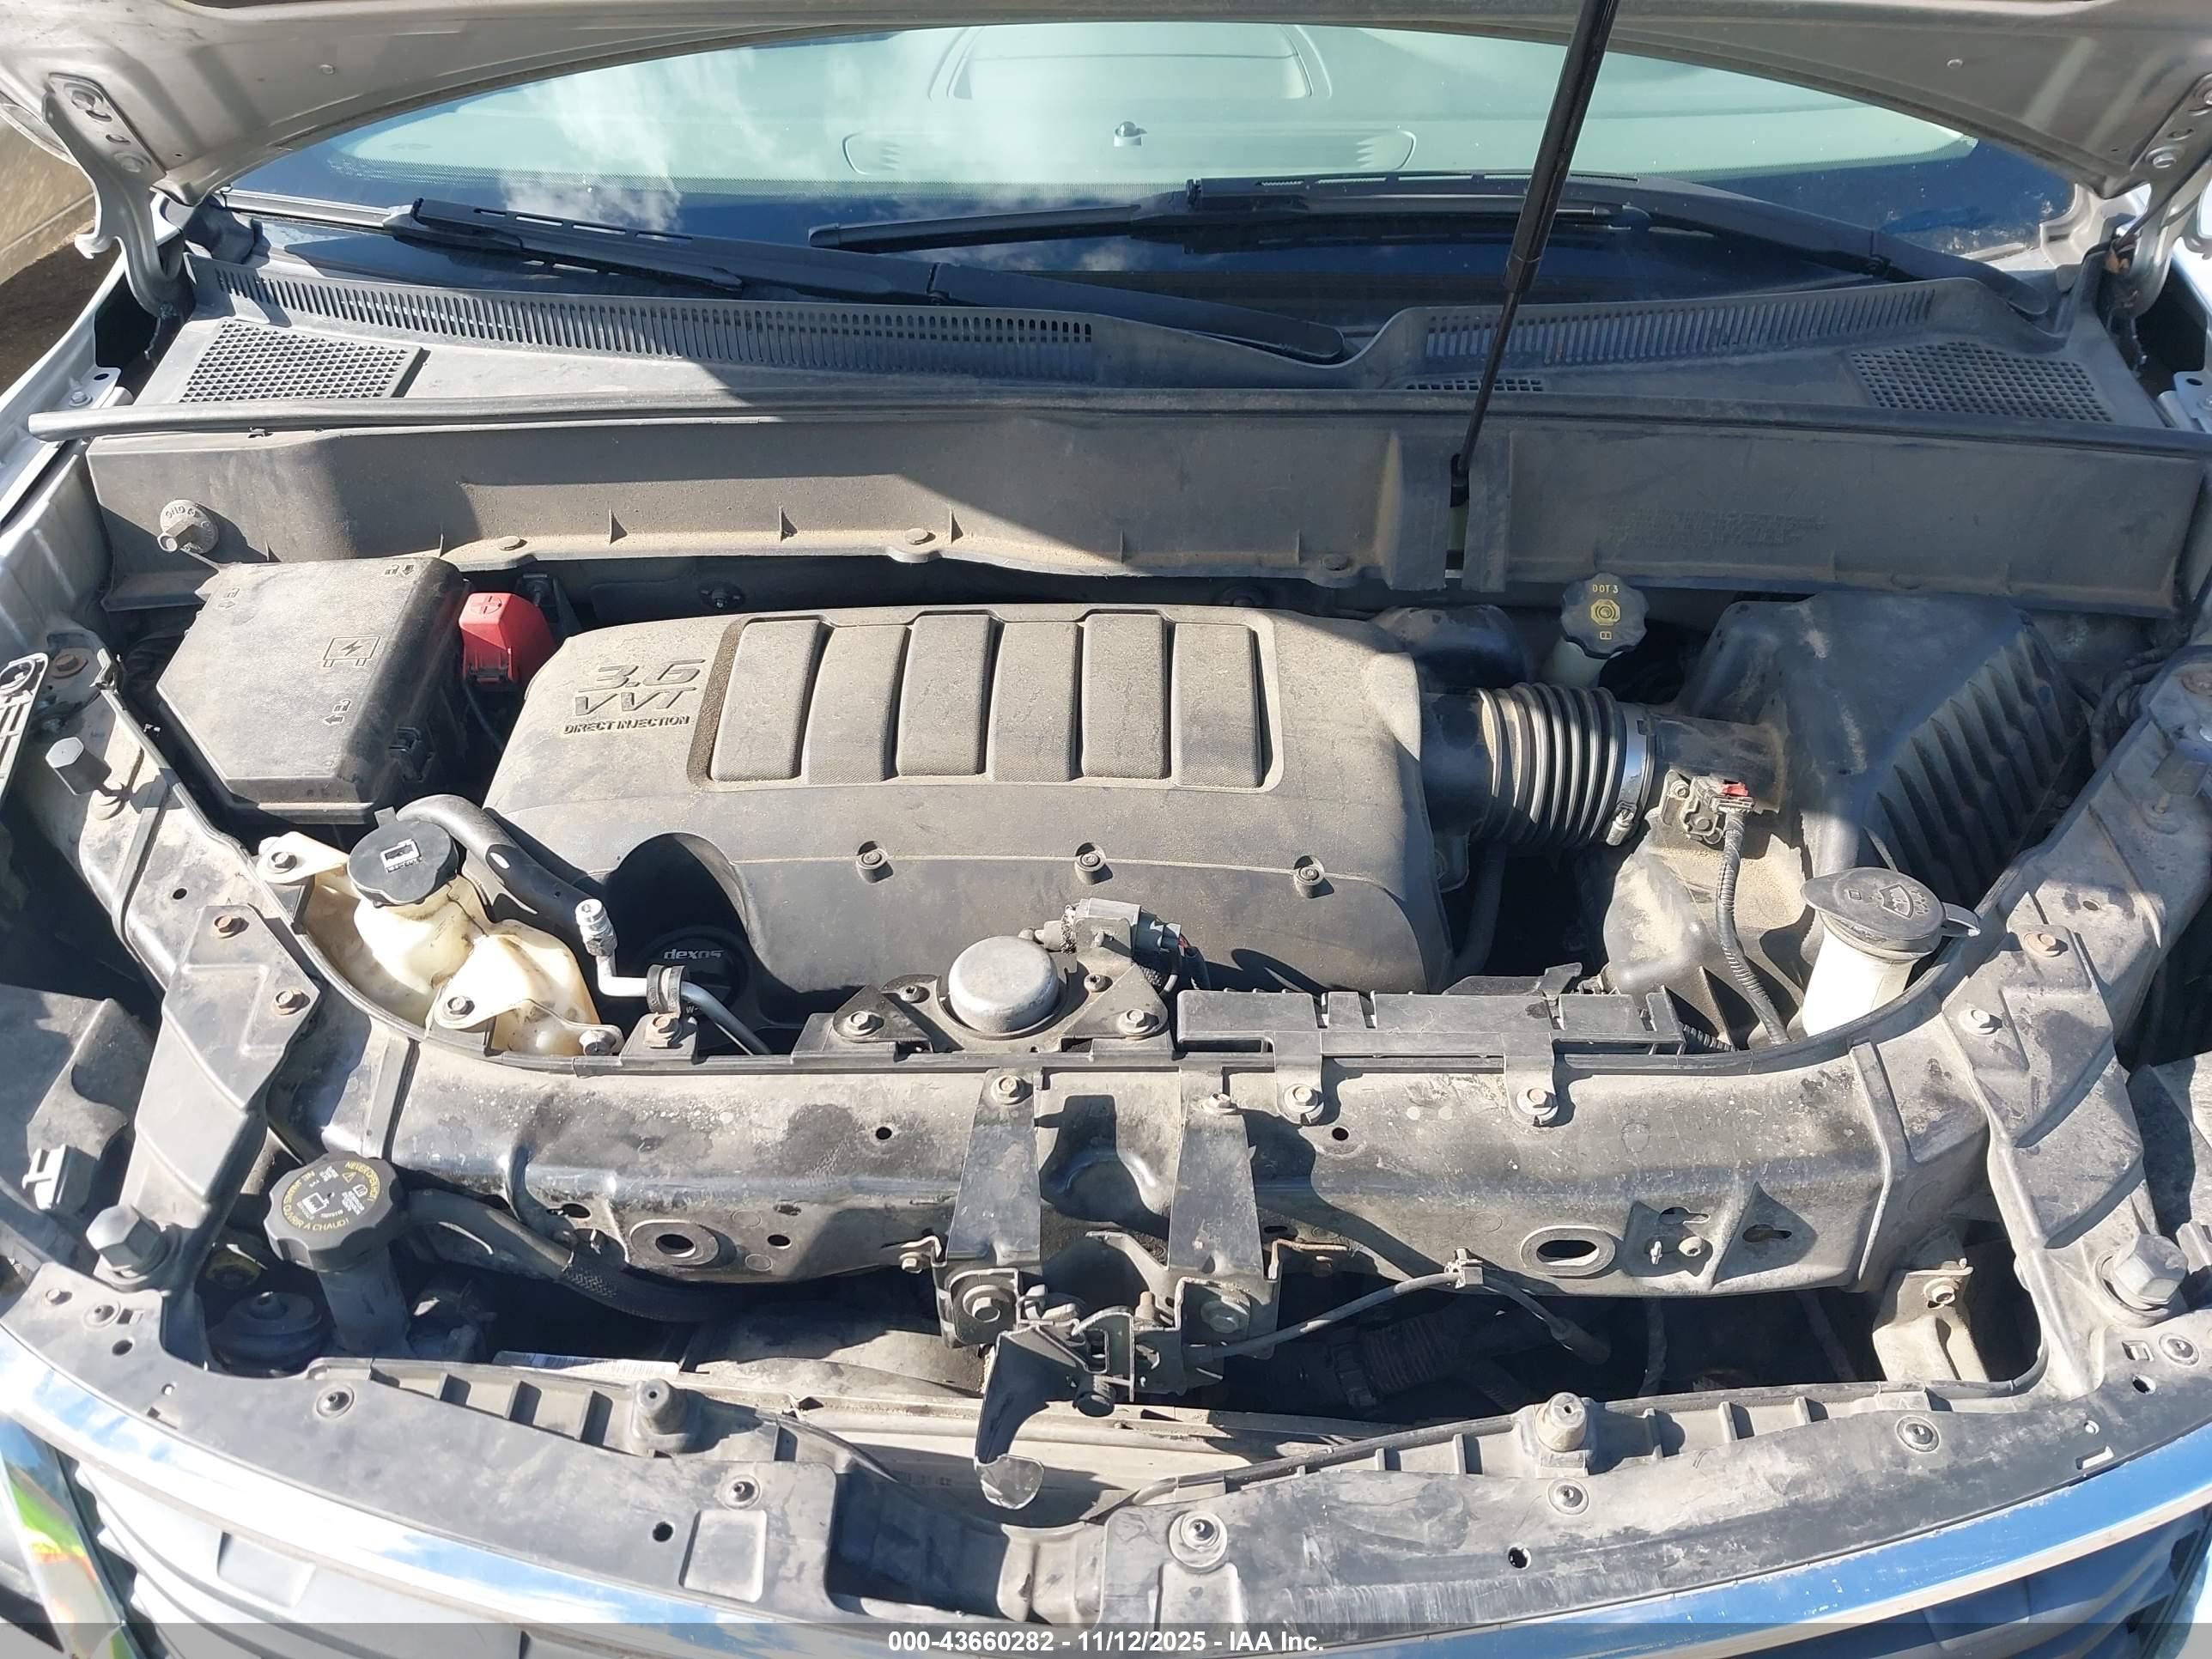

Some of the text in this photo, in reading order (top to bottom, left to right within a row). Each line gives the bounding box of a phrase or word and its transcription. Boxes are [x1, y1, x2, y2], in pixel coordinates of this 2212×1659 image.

[1613, 585, 1619, 594] 3
[578, 659, 706, 693] 3.6
[575, 687, 697, 716] VVT
[563, 715, 690, 734] DIRECT INJECTION
[664, 949, 724, 959] dexos
